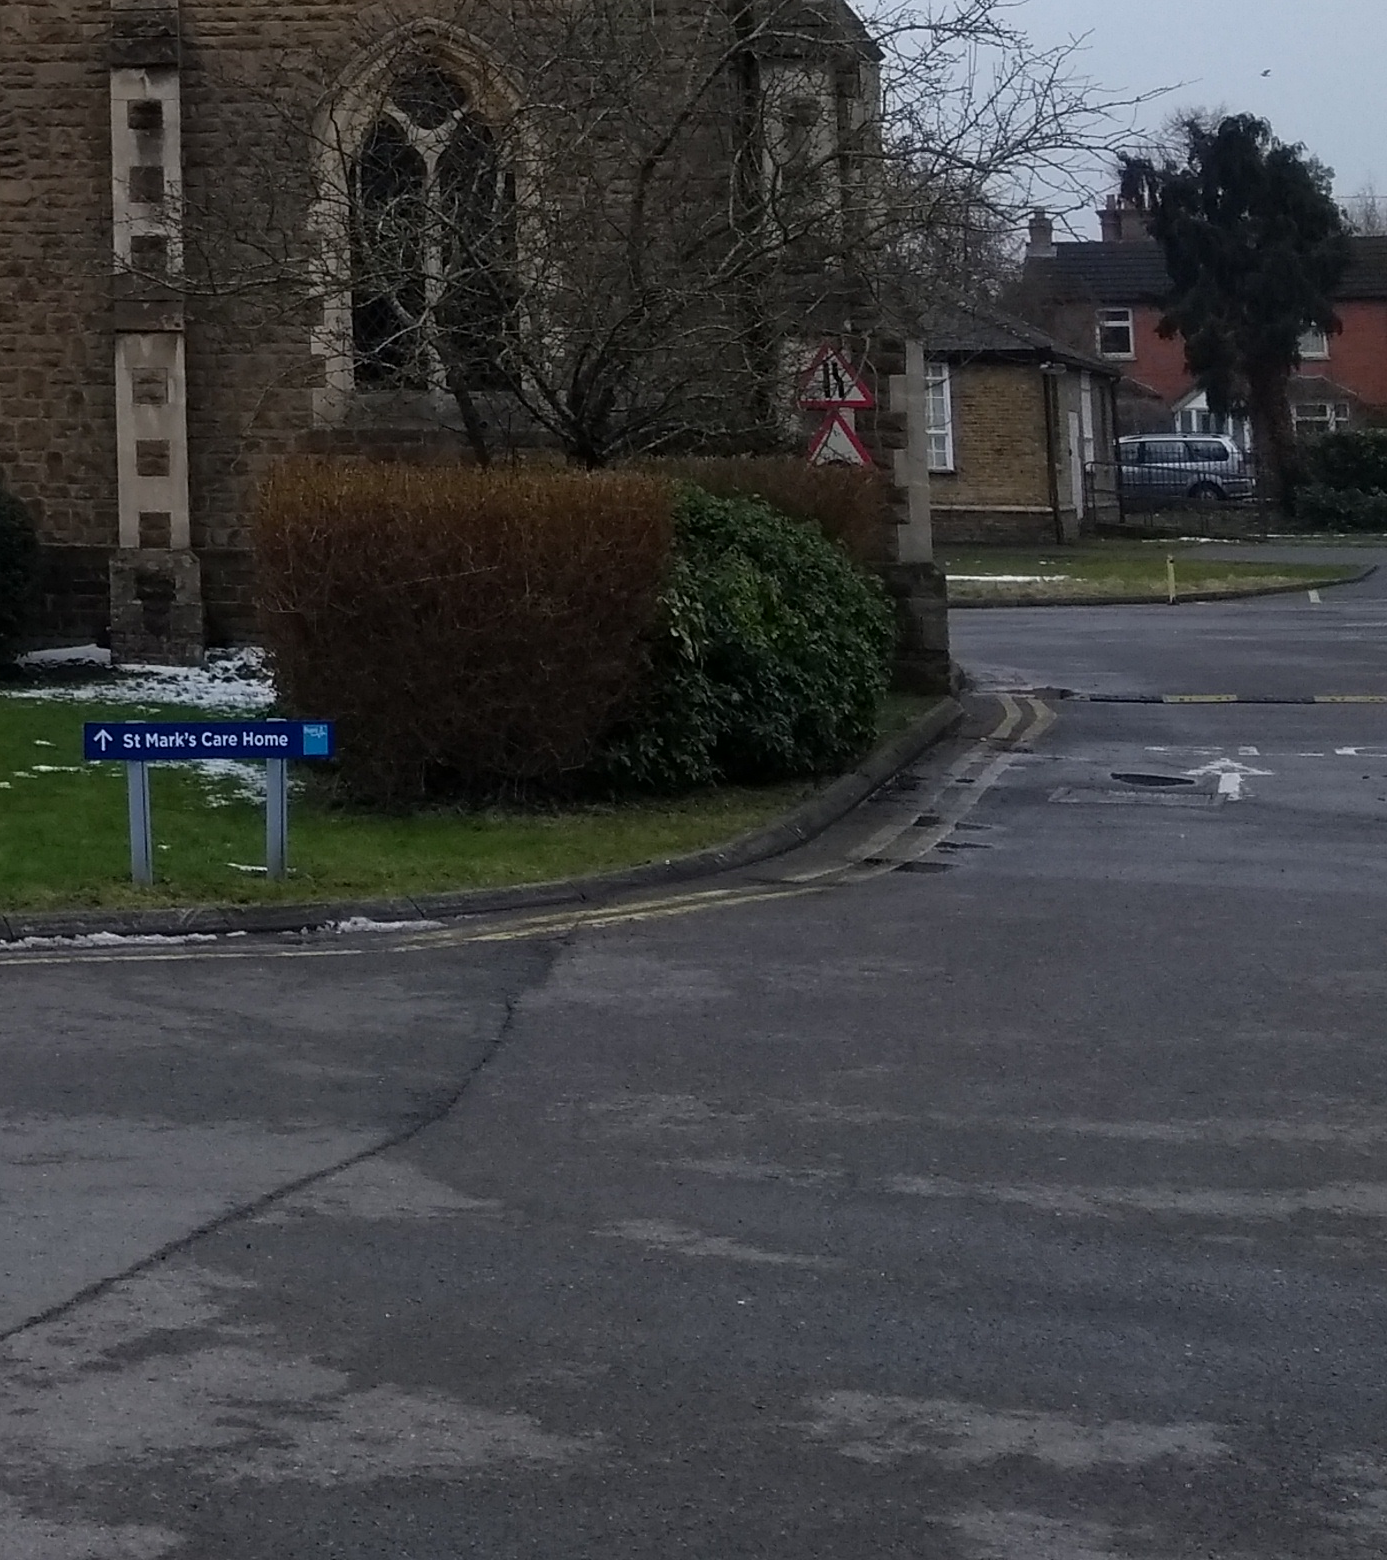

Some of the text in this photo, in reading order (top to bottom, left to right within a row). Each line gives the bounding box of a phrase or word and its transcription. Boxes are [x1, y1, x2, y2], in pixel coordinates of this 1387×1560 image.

[123, 733, 142, 749] St
[145, 732, 197, 748] Mark's
[201, 732, 238, 747] Care
[242, 731, 289, 746] Home
